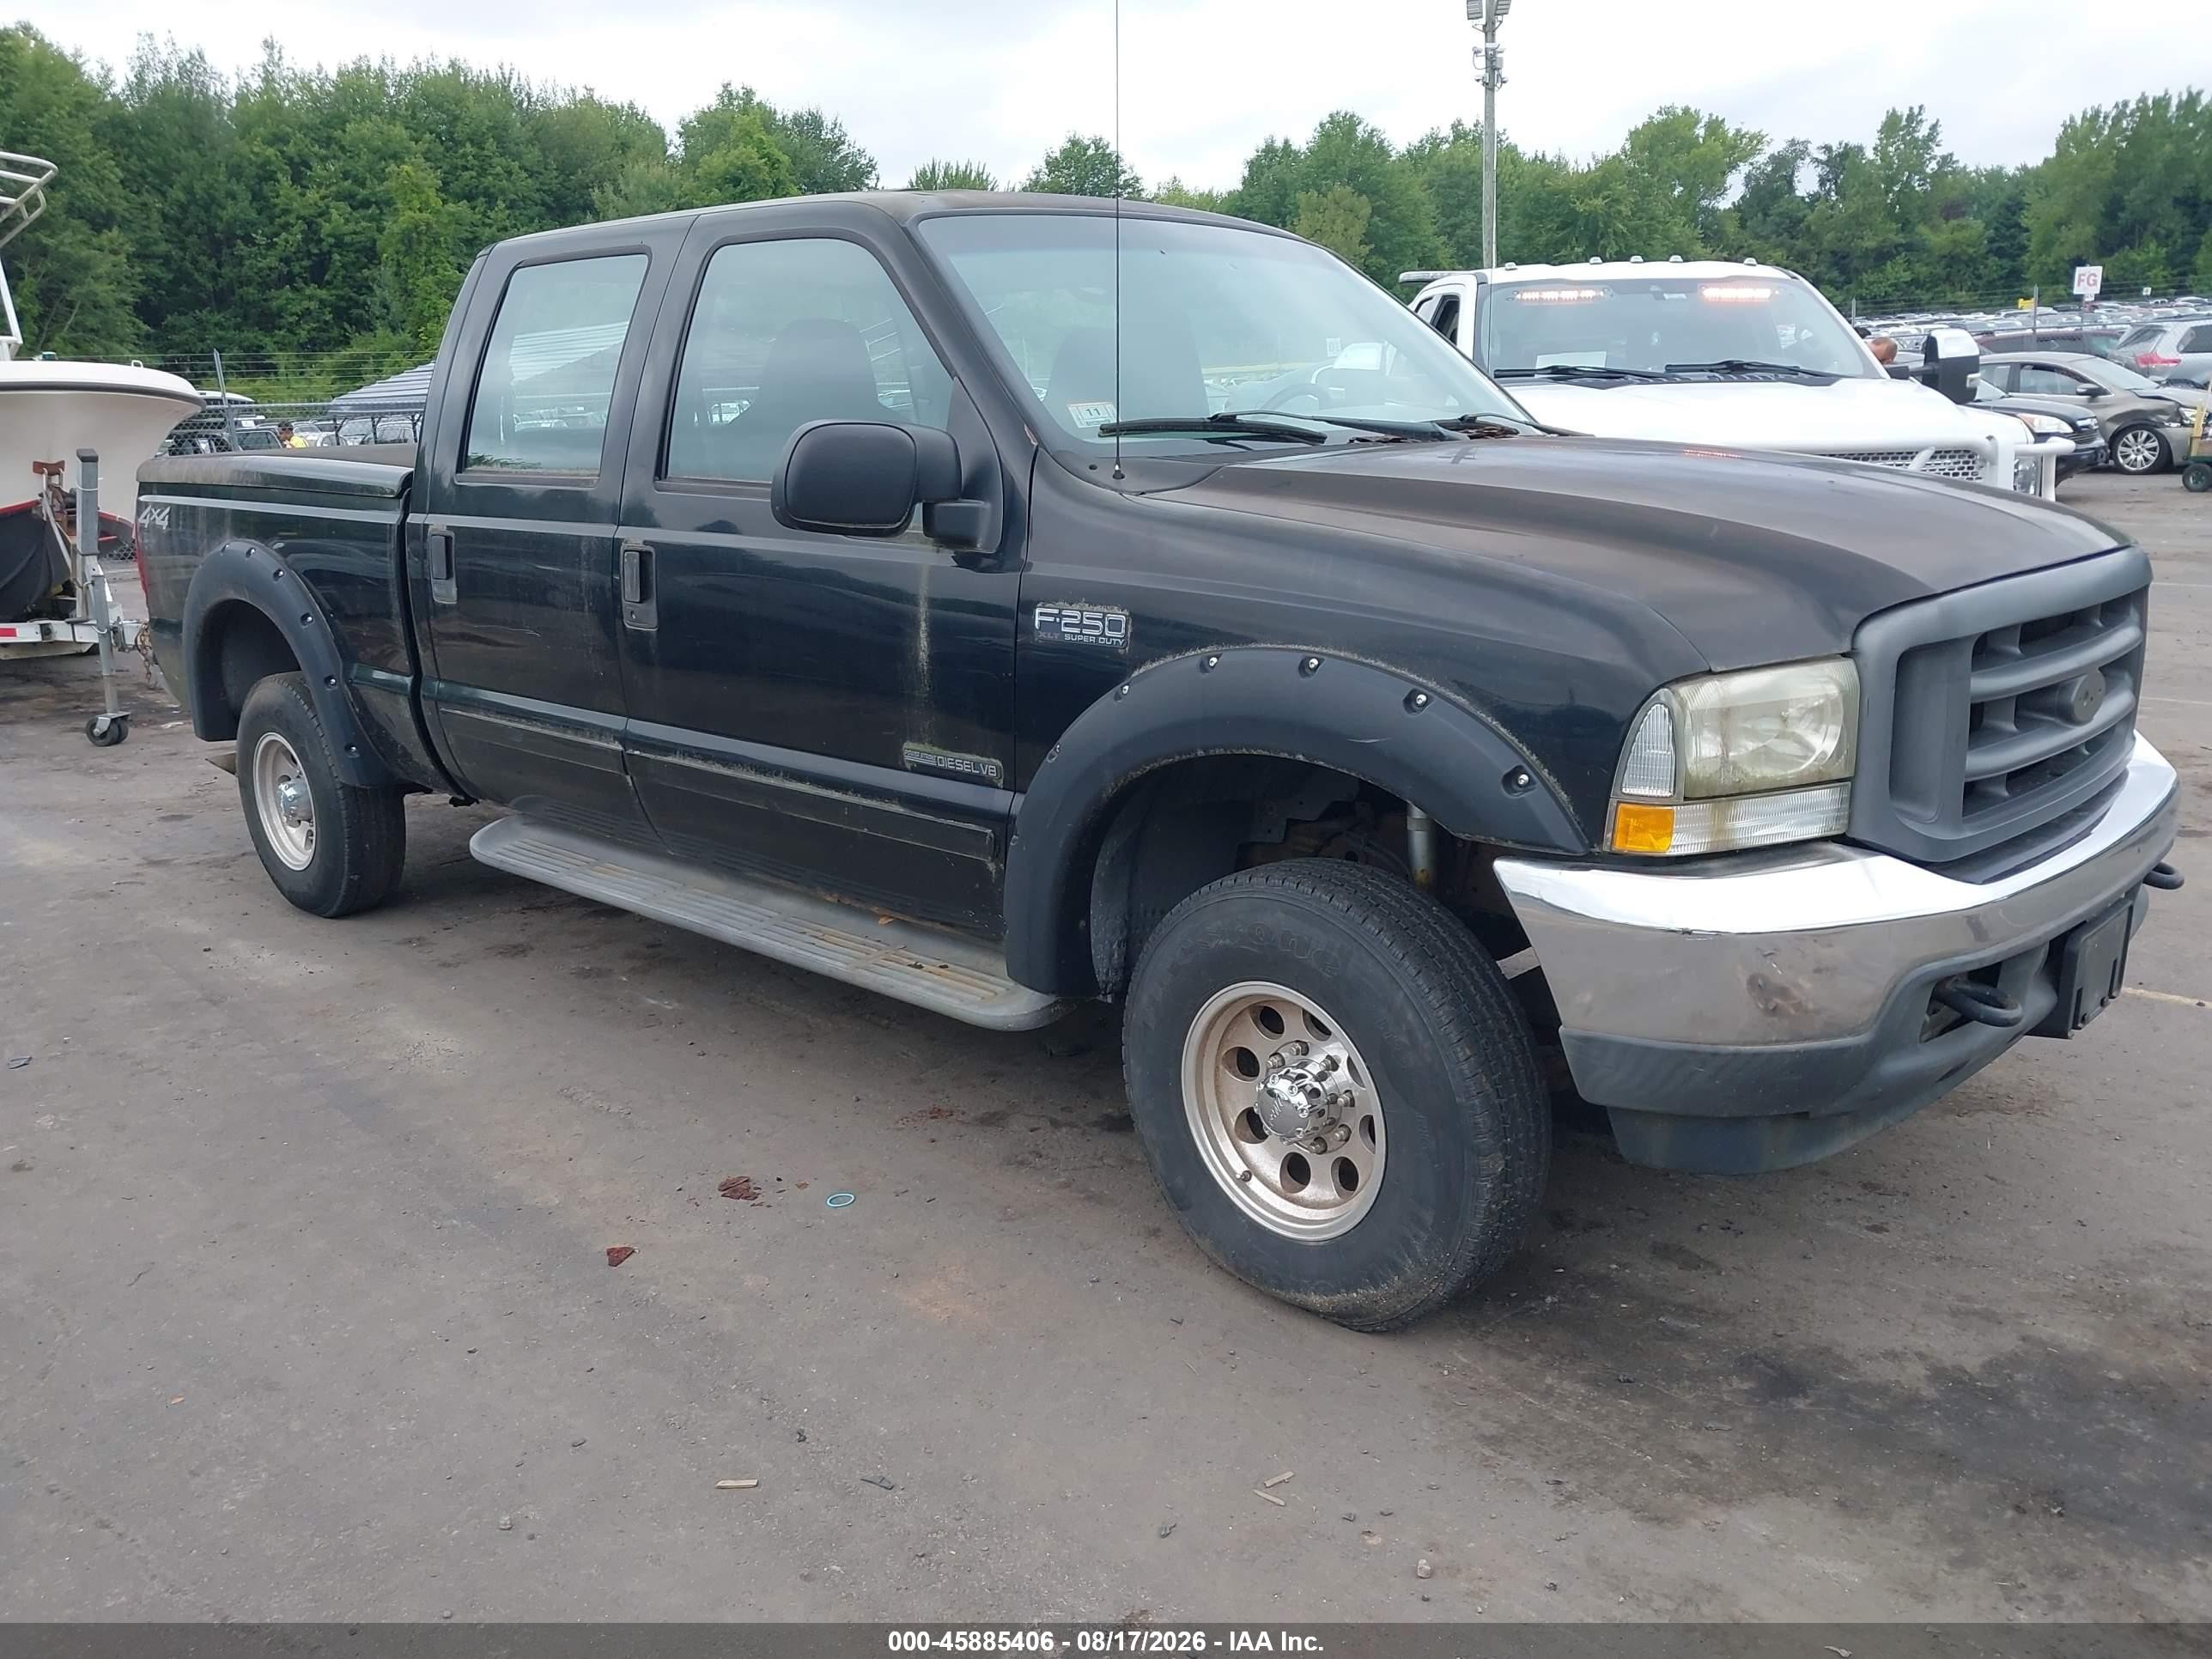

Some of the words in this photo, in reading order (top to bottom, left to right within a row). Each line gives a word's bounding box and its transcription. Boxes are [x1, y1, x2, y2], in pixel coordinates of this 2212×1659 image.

[2077, 272, 2098, 288] FG
[1064, 633, 1097, 644] SUPER
[1098, 636, 1125, 647] DUTY
[937, 756, 979, 774] DIESEL
[979, 763, 997, 777] V8
